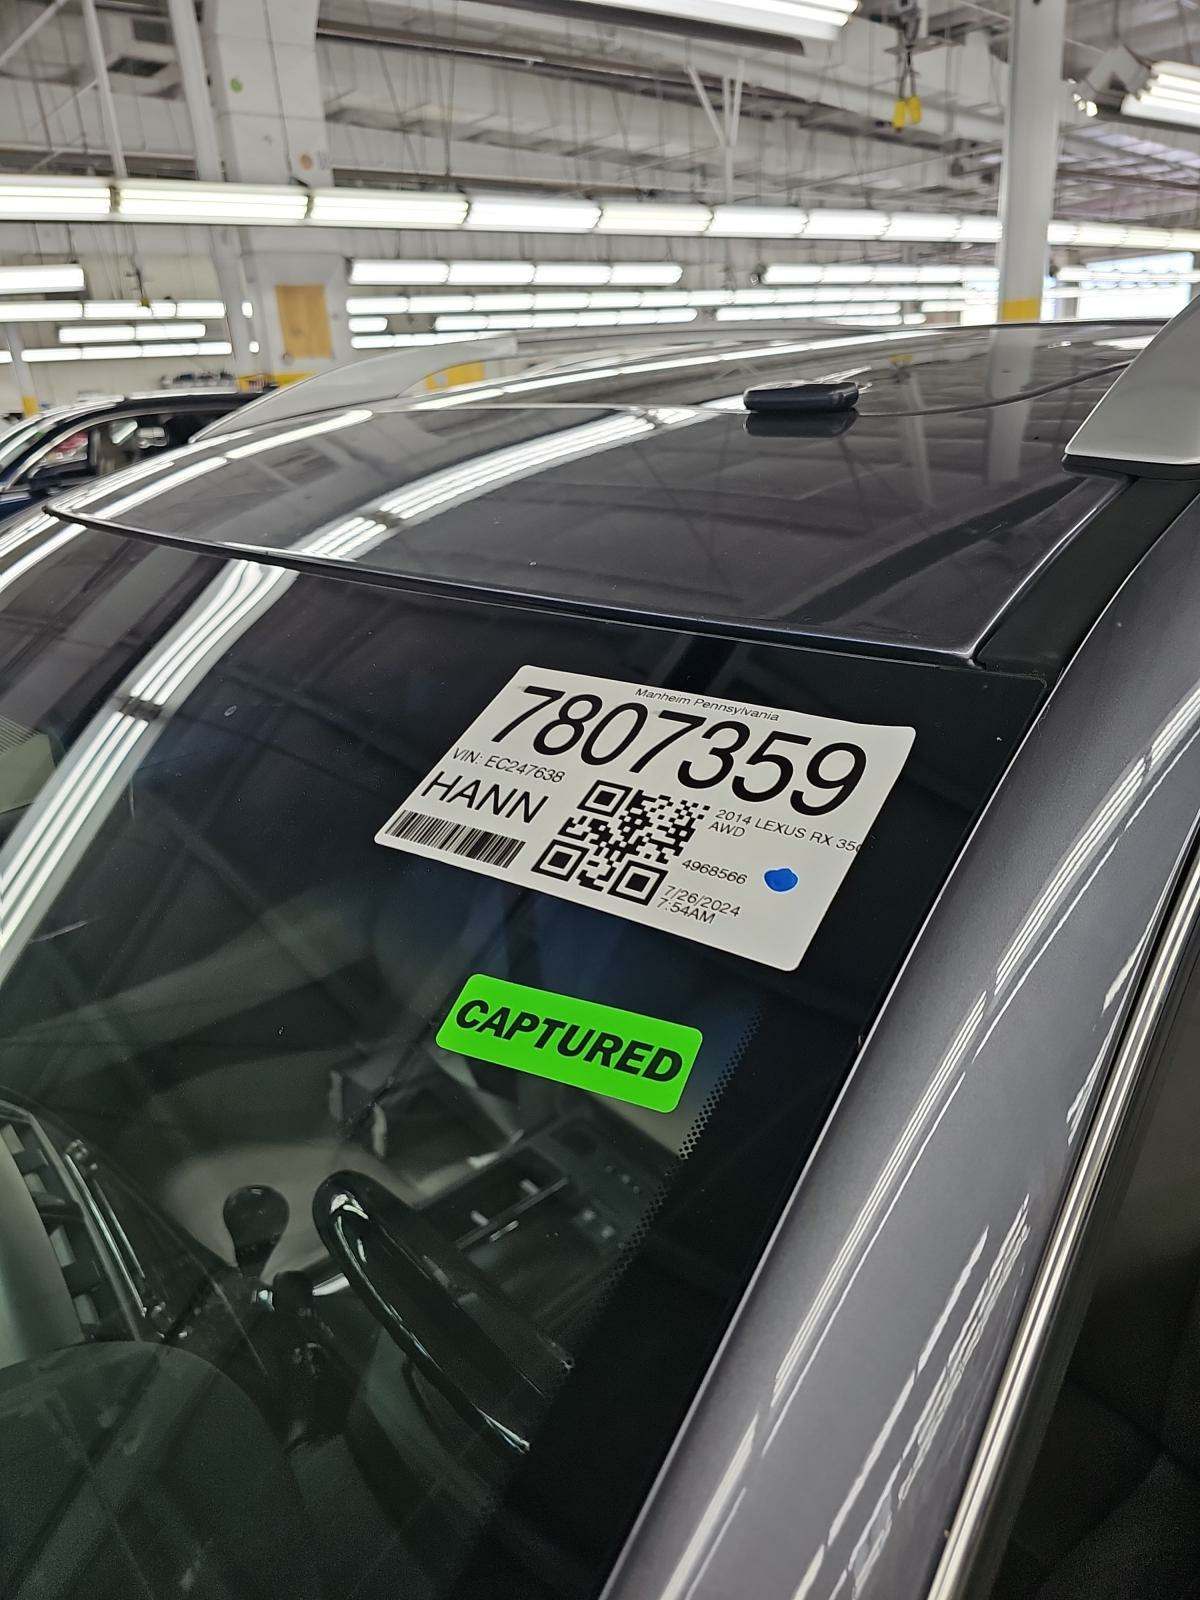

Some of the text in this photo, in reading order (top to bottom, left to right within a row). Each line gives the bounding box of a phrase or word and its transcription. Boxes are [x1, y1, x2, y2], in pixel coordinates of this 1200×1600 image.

[635, 687, 780, 722] Manheim Pennsylvania
[452, 748, 565, 783] VIN: EC247638
[491, 685, 867, 816] 7807359
[421, 771, 548, 824] HANN
[708, 823, 746, 838] AWD
[715, 809, 752, 826] 2014
[754, 817, 807, 839] LEXUS
[809, 831, 834, 846] RX
[681, 859, 748, 885] 4968566
[656, 897, 716, 925] 7:54AM
[665, 885, 741, 918] 7/26/2024
[455, 999, 683, 1082] CAPTURED
